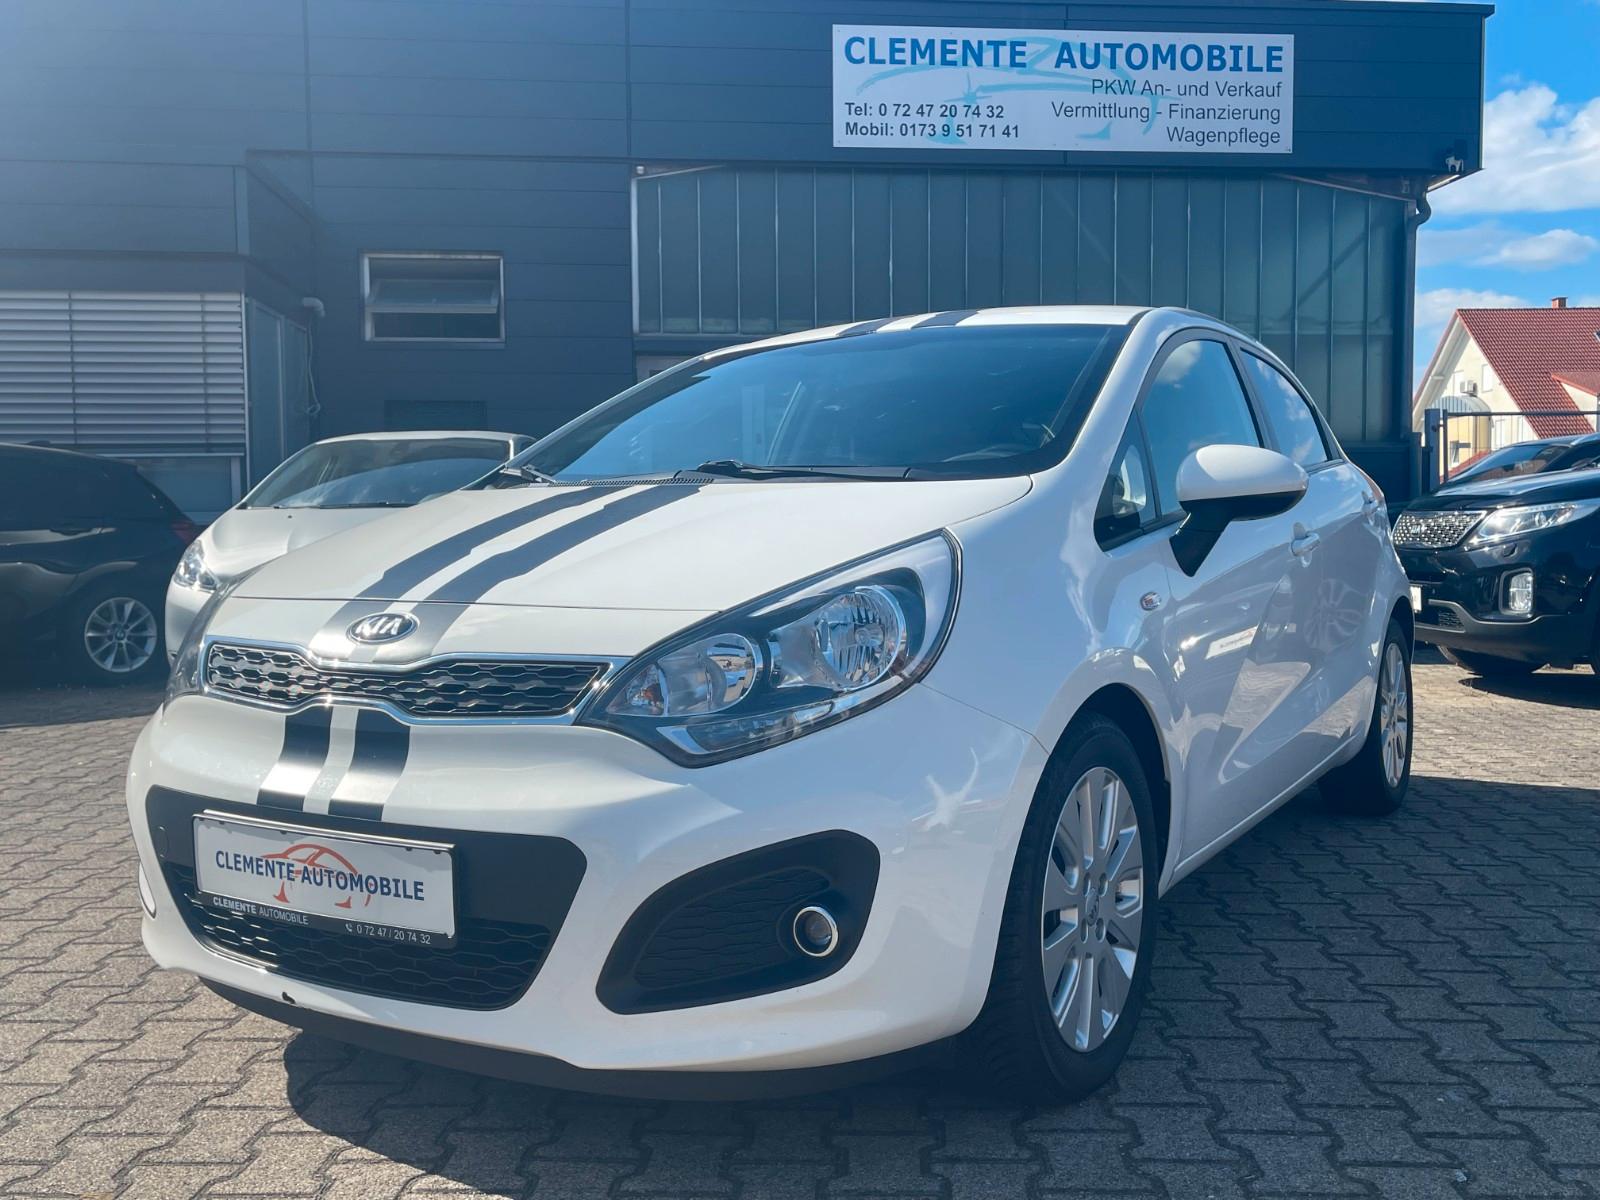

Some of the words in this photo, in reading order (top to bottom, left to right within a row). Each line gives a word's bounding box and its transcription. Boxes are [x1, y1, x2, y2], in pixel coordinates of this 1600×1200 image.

[844, 36, 1027, 68] CLEMENTE
[1054, 41, 1284, 73] AUTOMOBILE
[1092, 79, 1136, 95] PKW
[1141, 81, 1171, 96] An-
[1177, 82, 1209, 97] und
[1215, 81, 1282, 98] Verkauf
[845, 102, 873, 117] Tel:
[878, 103, 888, 117] 0
[893, 103, 911, 118] 72
[916, 104, 934, 118] 47
[939, 104, 958, 119] 20
[963, 104, 982, 119] 74
[986, 105, 1005, 119] 32
[1051, 101, 1150, 122] Vermittlung
[1168, 103, 1281, 125] Finanzierung
[845, 121, 894, 137] Mobil:
[899, 123, 937, 137] 0173
[941, 124, 951, 137] 9
[956, 124, 973, 138] 51
[979, 124, 996, 138] 71
[1002, 124, 1019, 138] 41
[1166, 126, 1281, 147] Wagenpflege
[355, 616, 402, 636] KIA
[215, 850, 296, 882] CLEMENTE
[301, 865, 425, 901] AUTOMOBILE
[213, 896, 257, 914] CLEMENTE
[259, 906, 309, 925] AUTOMOBILE
[356, 924, 363, 934] 0
[365, 925, 375, 936] 72
[377, 927, 387, 937] 47
[394, 930, 405, 941] 20
[407, 931, 417, 942] 74
[420, 933, 431, 945] 32
